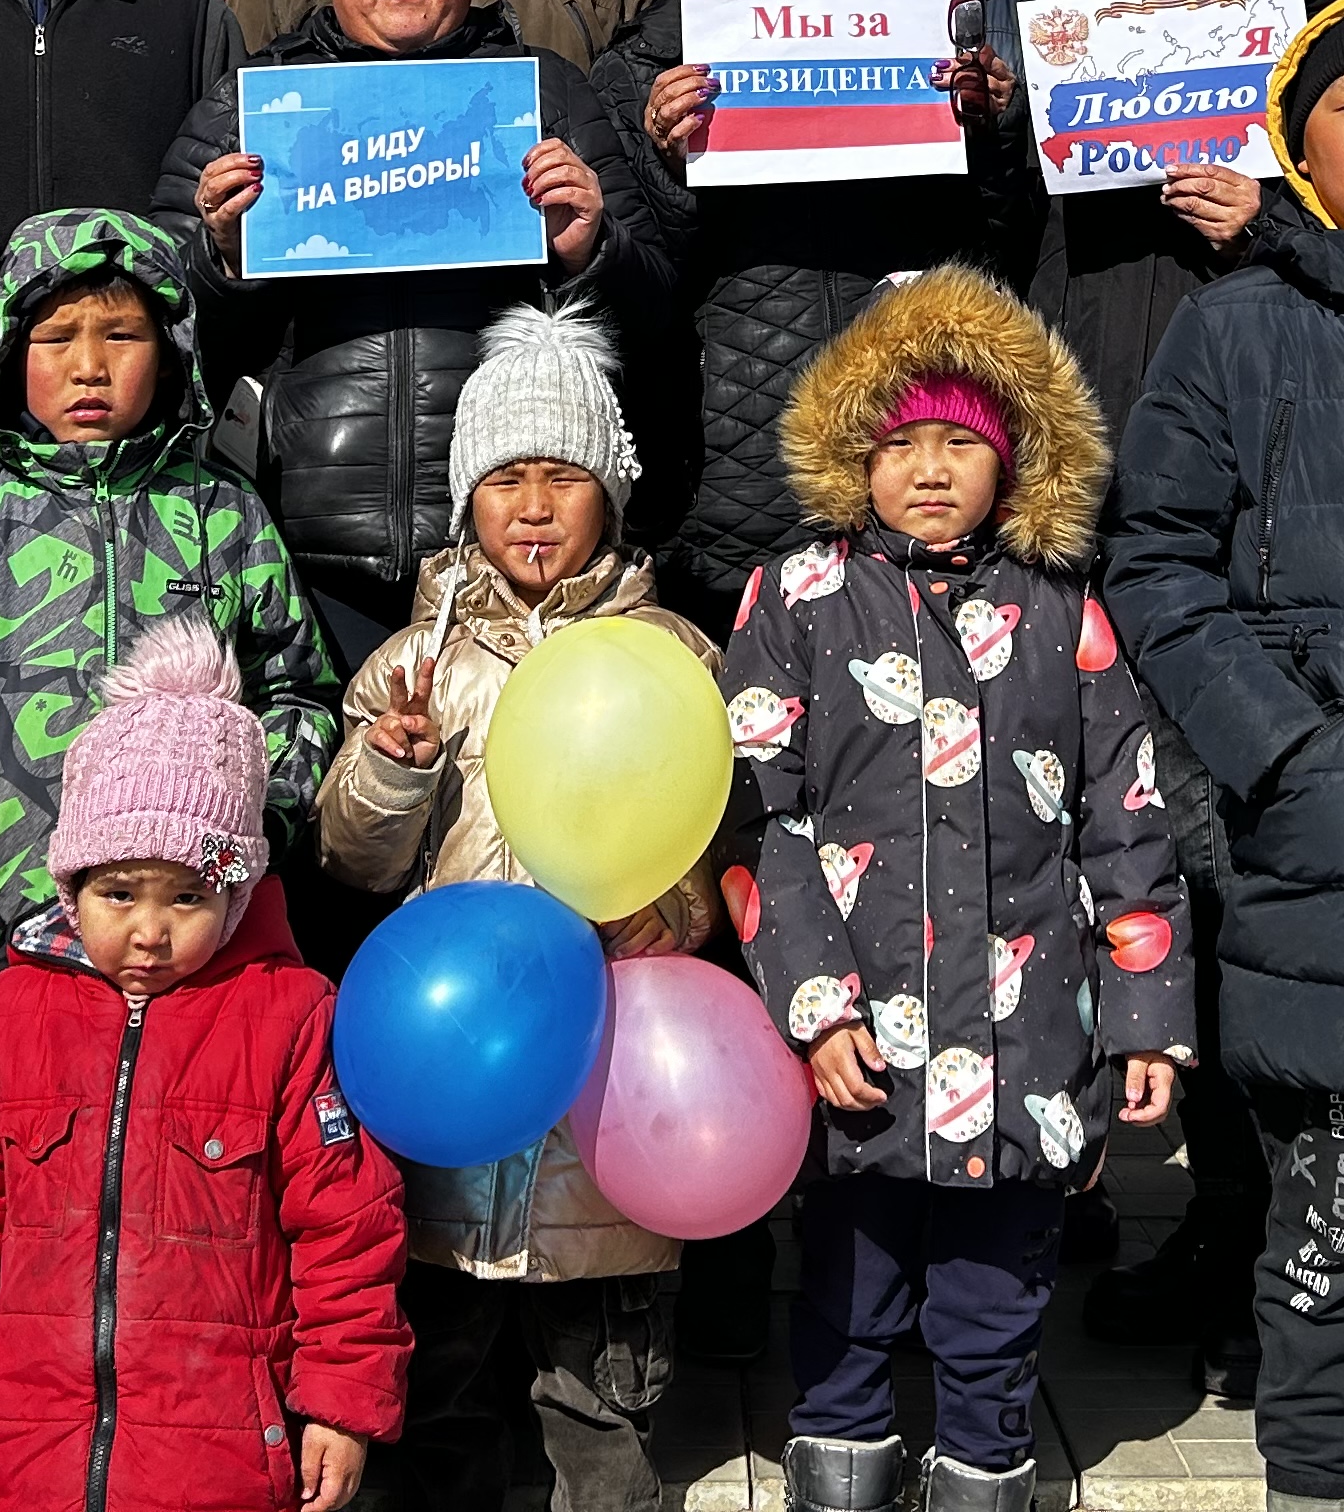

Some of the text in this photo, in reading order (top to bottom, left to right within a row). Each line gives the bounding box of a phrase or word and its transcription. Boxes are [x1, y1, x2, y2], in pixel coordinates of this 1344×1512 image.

[751, 5, 891, 39] Мы за
[1238, 26, 1275, 58] Я
[1067, 82, 1258, 126] Люблю
[340, 126, 426, 166] Я ИДУ
[1077, 134, 1242, 176] Россию
[296, 141, 481, 212] НА ВЫБОРЫ!
